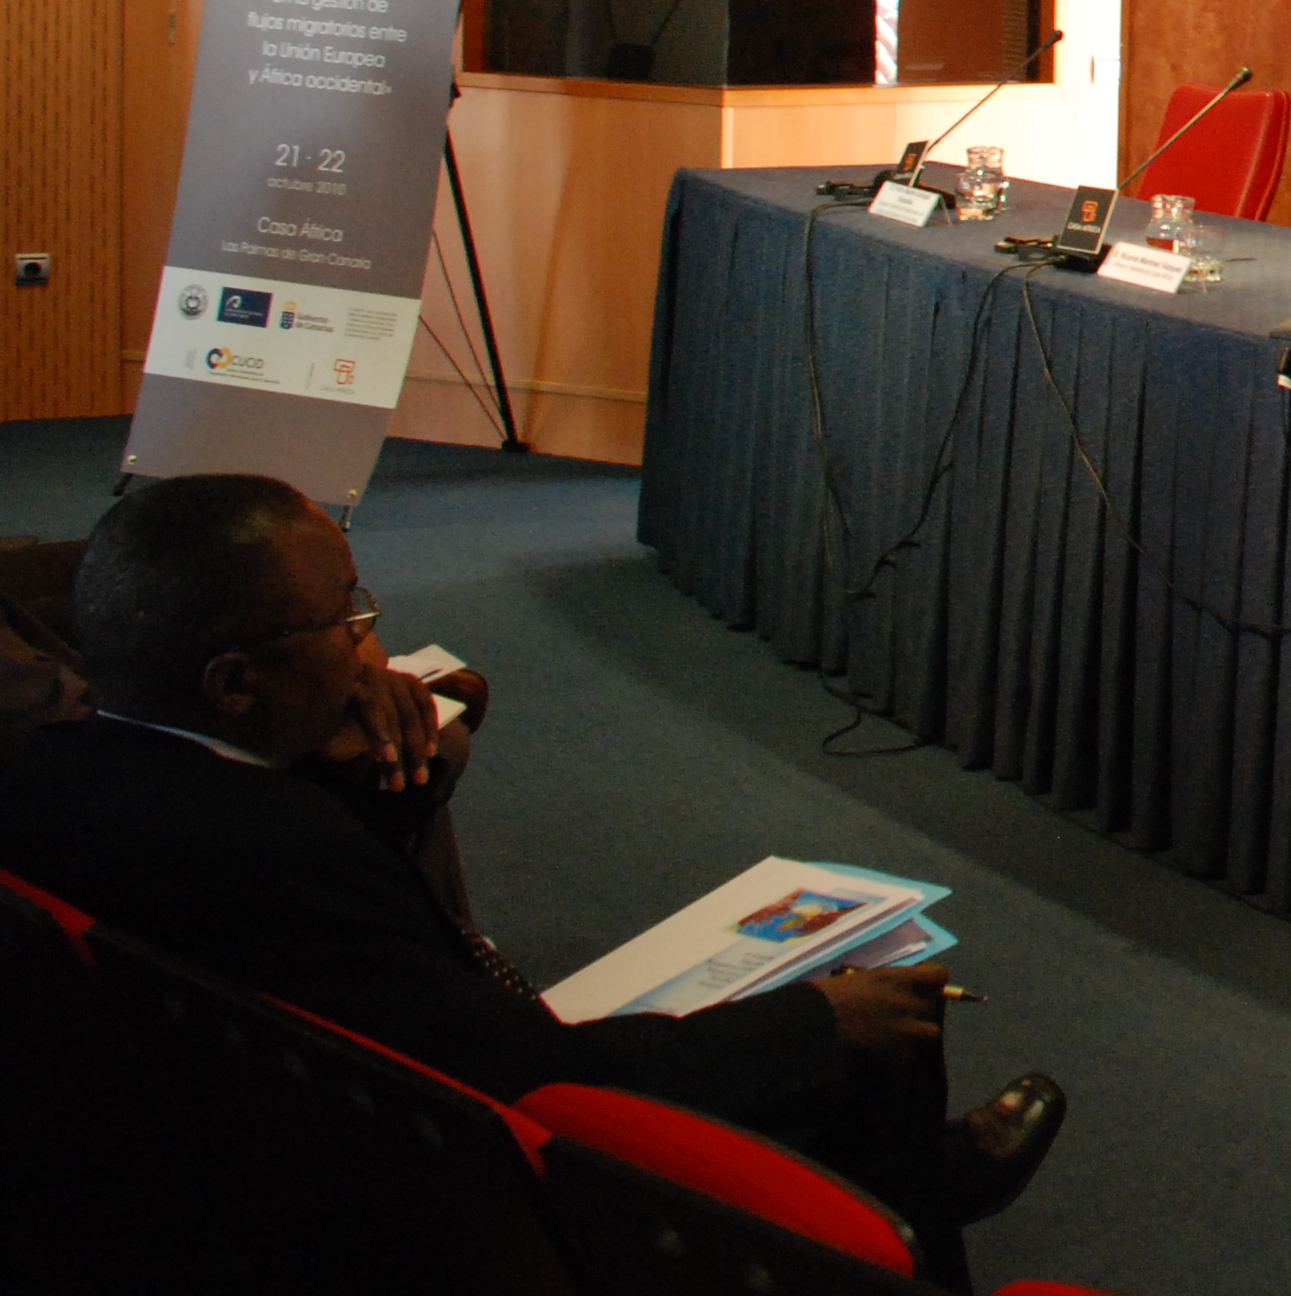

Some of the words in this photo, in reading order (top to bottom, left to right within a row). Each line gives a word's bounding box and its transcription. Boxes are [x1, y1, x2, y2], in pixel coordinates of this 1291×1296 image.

[247, 11, 284, 32] flujos
[286, 17, 366, 39] migratorios
[369, 25, 408, 43] entre
[262, 40, 277, 56] la
[280, 42, 321, 61] Unión
[323, 46, 386, 69] Europea
[248, 69, 259, 85] y
[259, 63, 302, 87] África
[275, 143, 300, 167] 21
[317, 148, 346, 174] 22
[267, 177, 314, 192] octubre
[257, 216, 297, 236] Casa
[299, 218, 343, 243] África
[222, 240, 239, 252] Las
[241, 241, 280, 258] Palmas
[281, 247, 297, 259] de
[299, 249, 325, 263] Gran
[327, 253, 372, 270] Canaria
